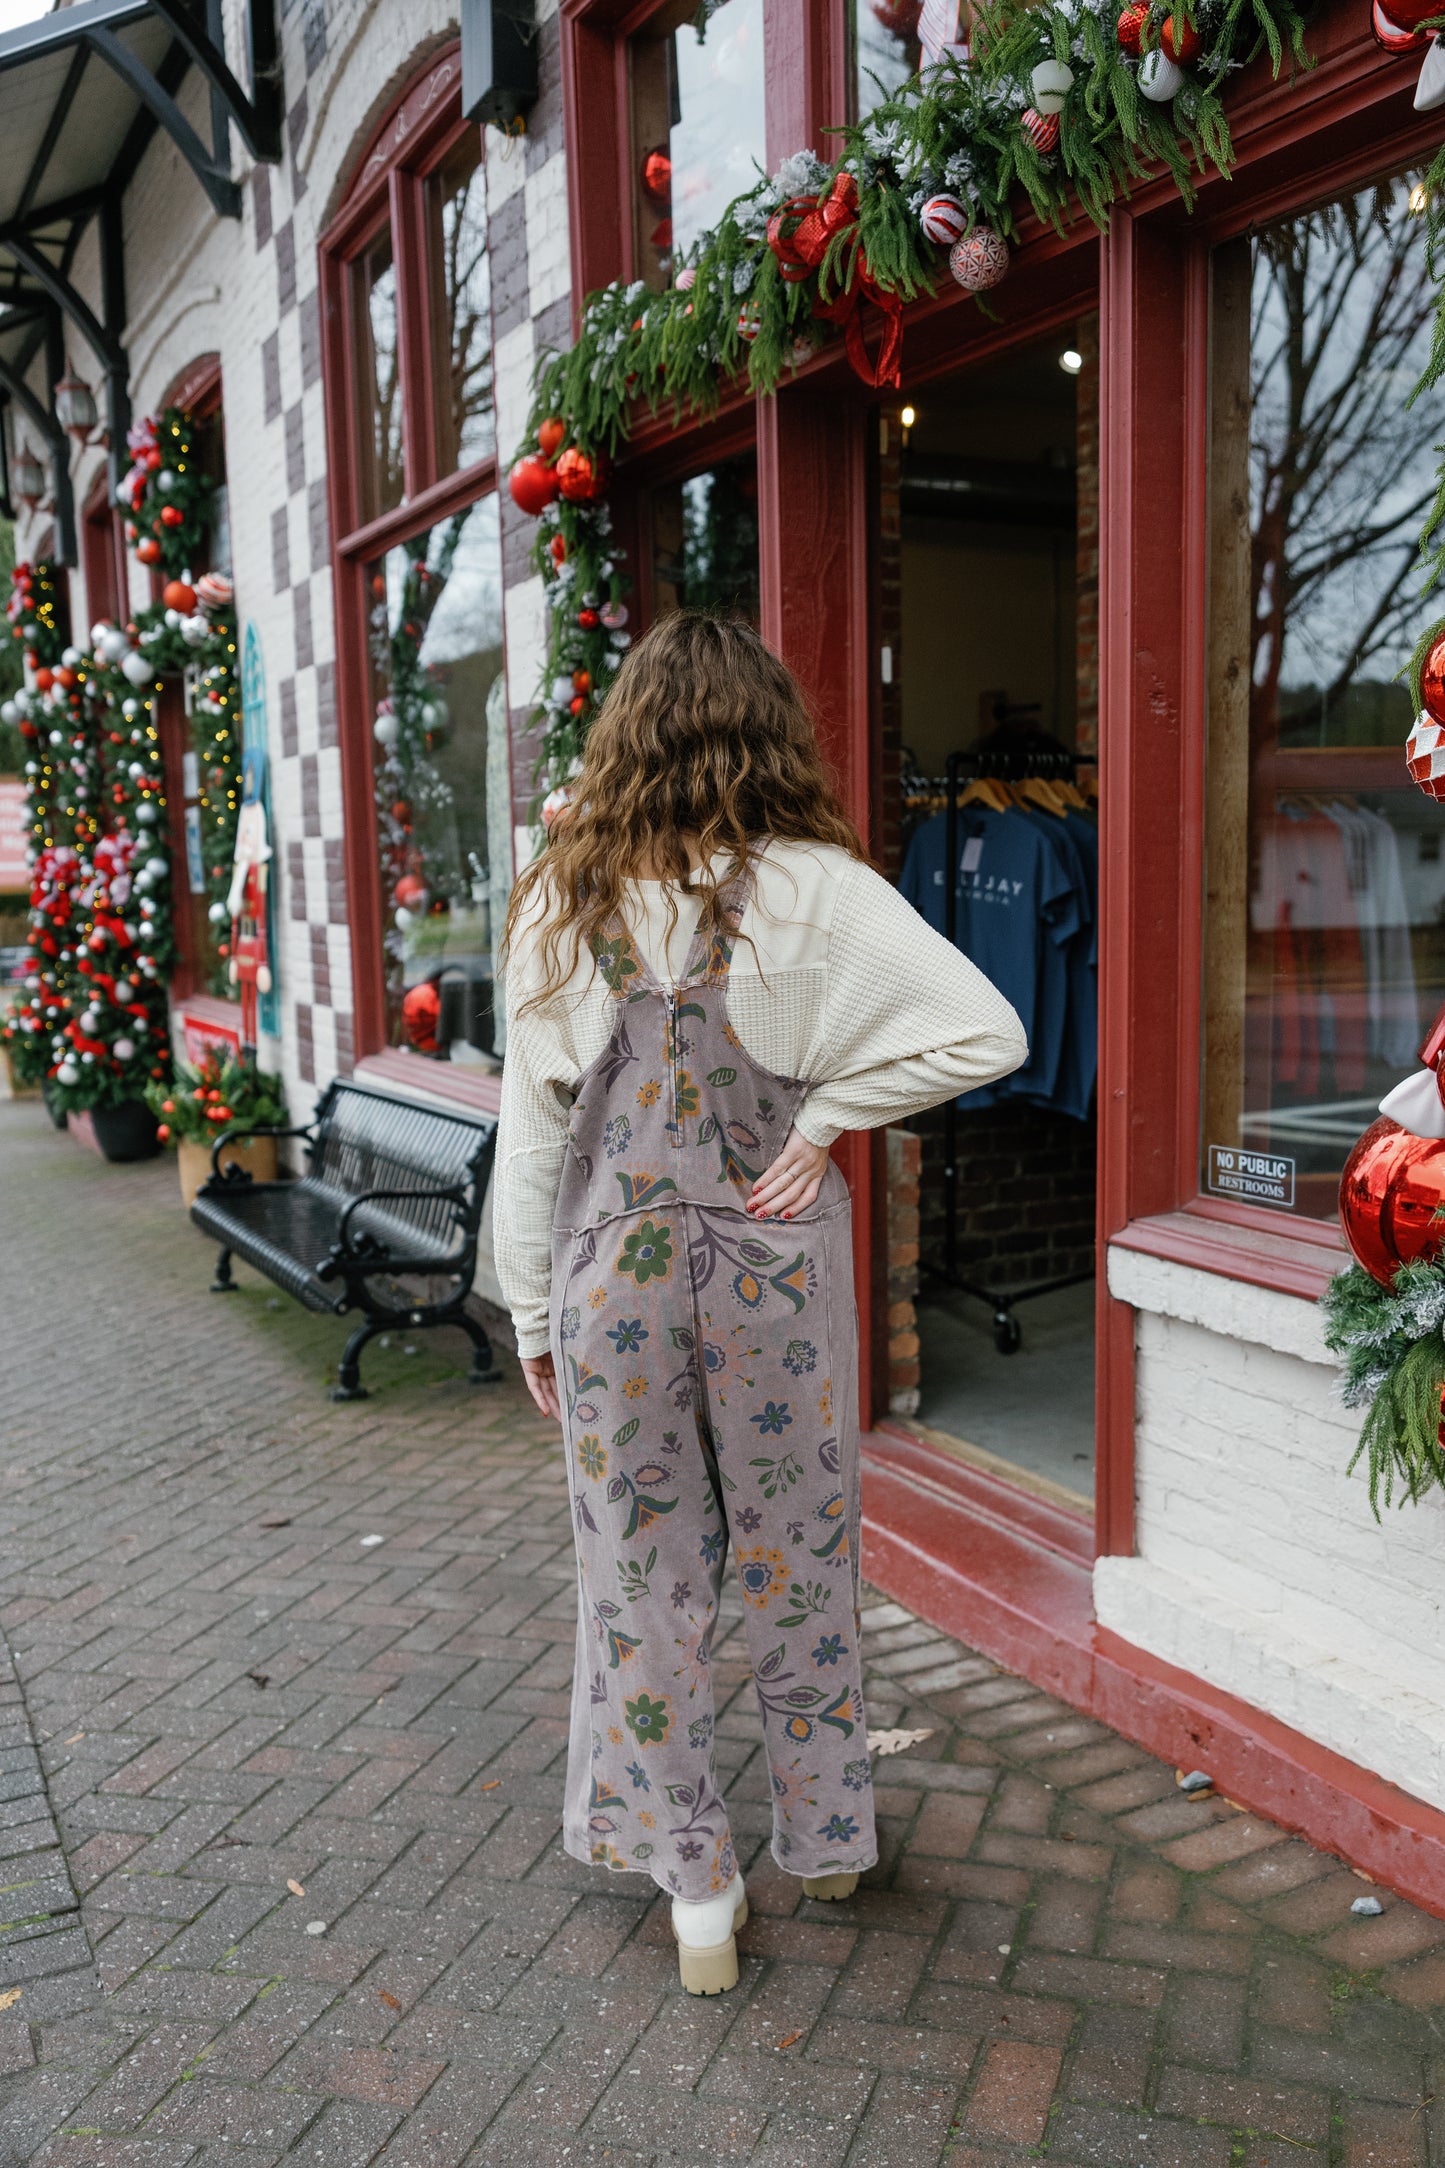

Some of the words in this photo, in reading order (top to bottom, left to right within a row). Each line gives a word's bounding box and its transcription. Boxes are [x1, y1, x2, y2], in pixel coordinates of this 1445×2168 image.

[933, 870, 1023, 896] ELIJAY
[1216, 1151, 1234, 1169] NO
[1238, 1155, 1287, 1179] PUBLIC
[1218, 1174, 1285, 1198] RESTROOMS
